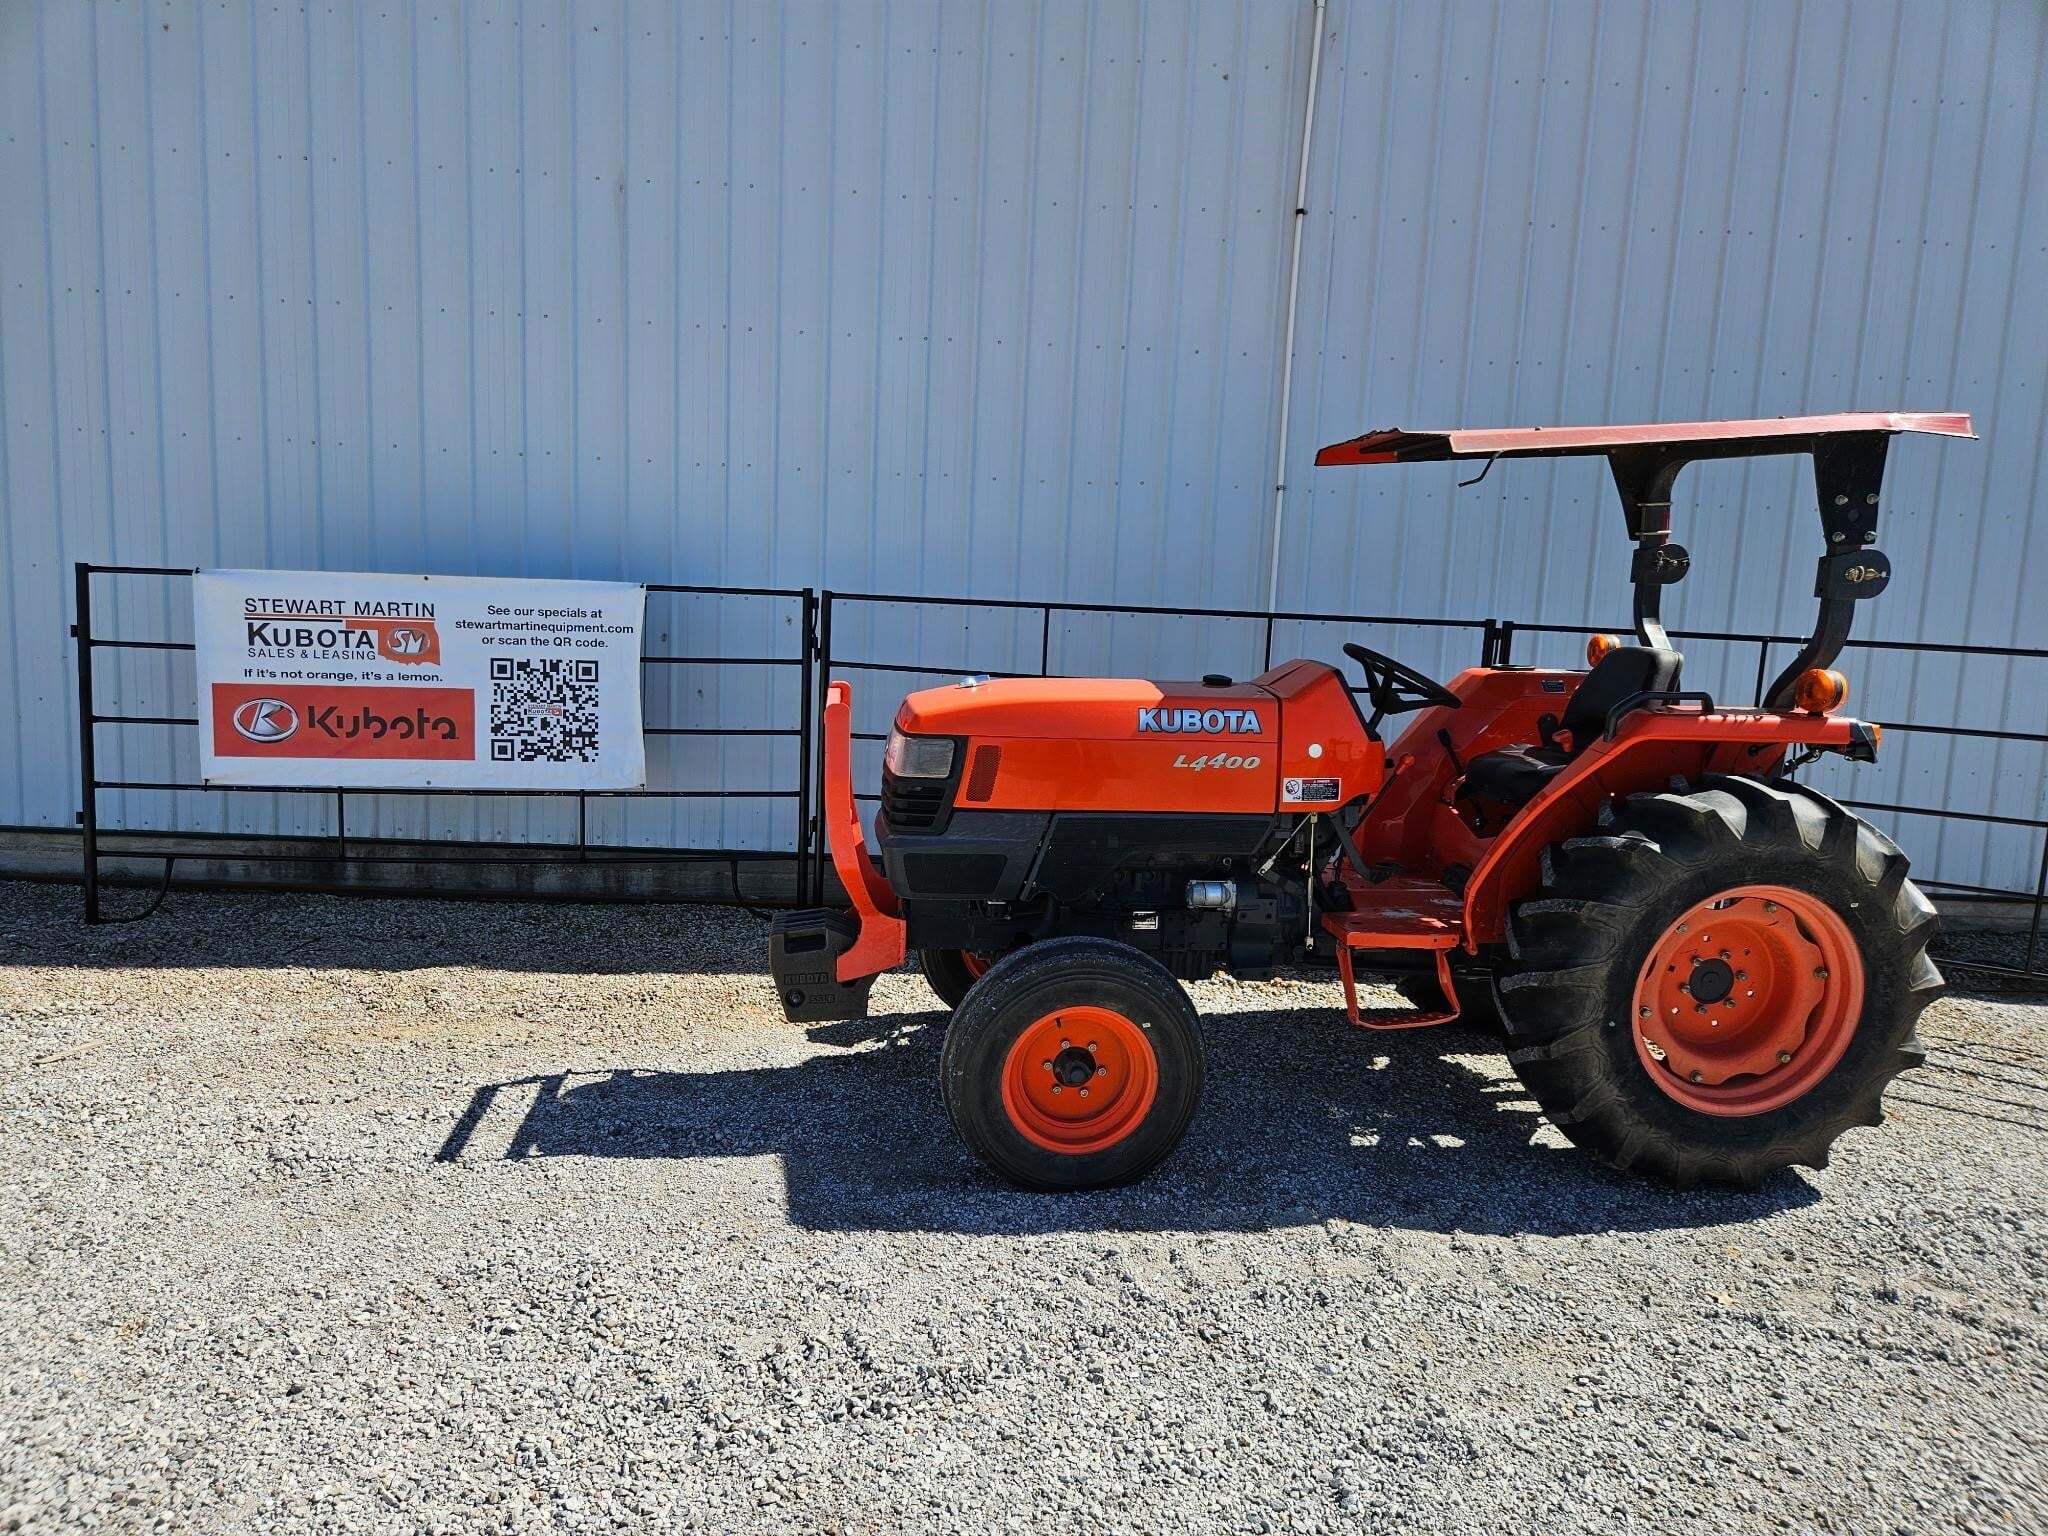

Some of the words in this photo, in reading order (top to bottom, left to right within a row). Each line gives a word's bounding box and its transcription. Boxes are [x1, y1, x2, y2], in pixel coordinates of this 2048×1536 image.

[245, 598, 346, 615] STEWART
[354, 601, 435, 618] MARTIN
[487, 605, 511, 616] See
[514, 607, 535, 616] our
[537, 607, 588, 619] specials
[590, 609, 603, 619] at
[455, 619, 634, 634] stewartmartinequipment.com
[247, 622, 375, 649] KUBOTA
[481, 636, 496, 645] or
[497, 637, 527, 646] scan
[530, 636, 550, 647] the
[553, 637, 573, 648] QR
[575, 637, 609, 648] code.
[248, 648, 296, 659] SALES
[301, 649, 309, 659] &
[313, 649, 377, 660] LEASING
[244, 668, 253, 678] If
[257, 669, 277, 679] it's
[280, 671, 304, 680] not
[306, 672, 358, 682] orange,
[361, 671, 382, 682] it's
[386, 673, 394, 681] a
[398, 671, 443, 682] lemon.
[308, 706, 459, 740] Kubota
[1138, 707, 1263, 735] KUBOTA
[1173, 752, 1261, 772] L4400
